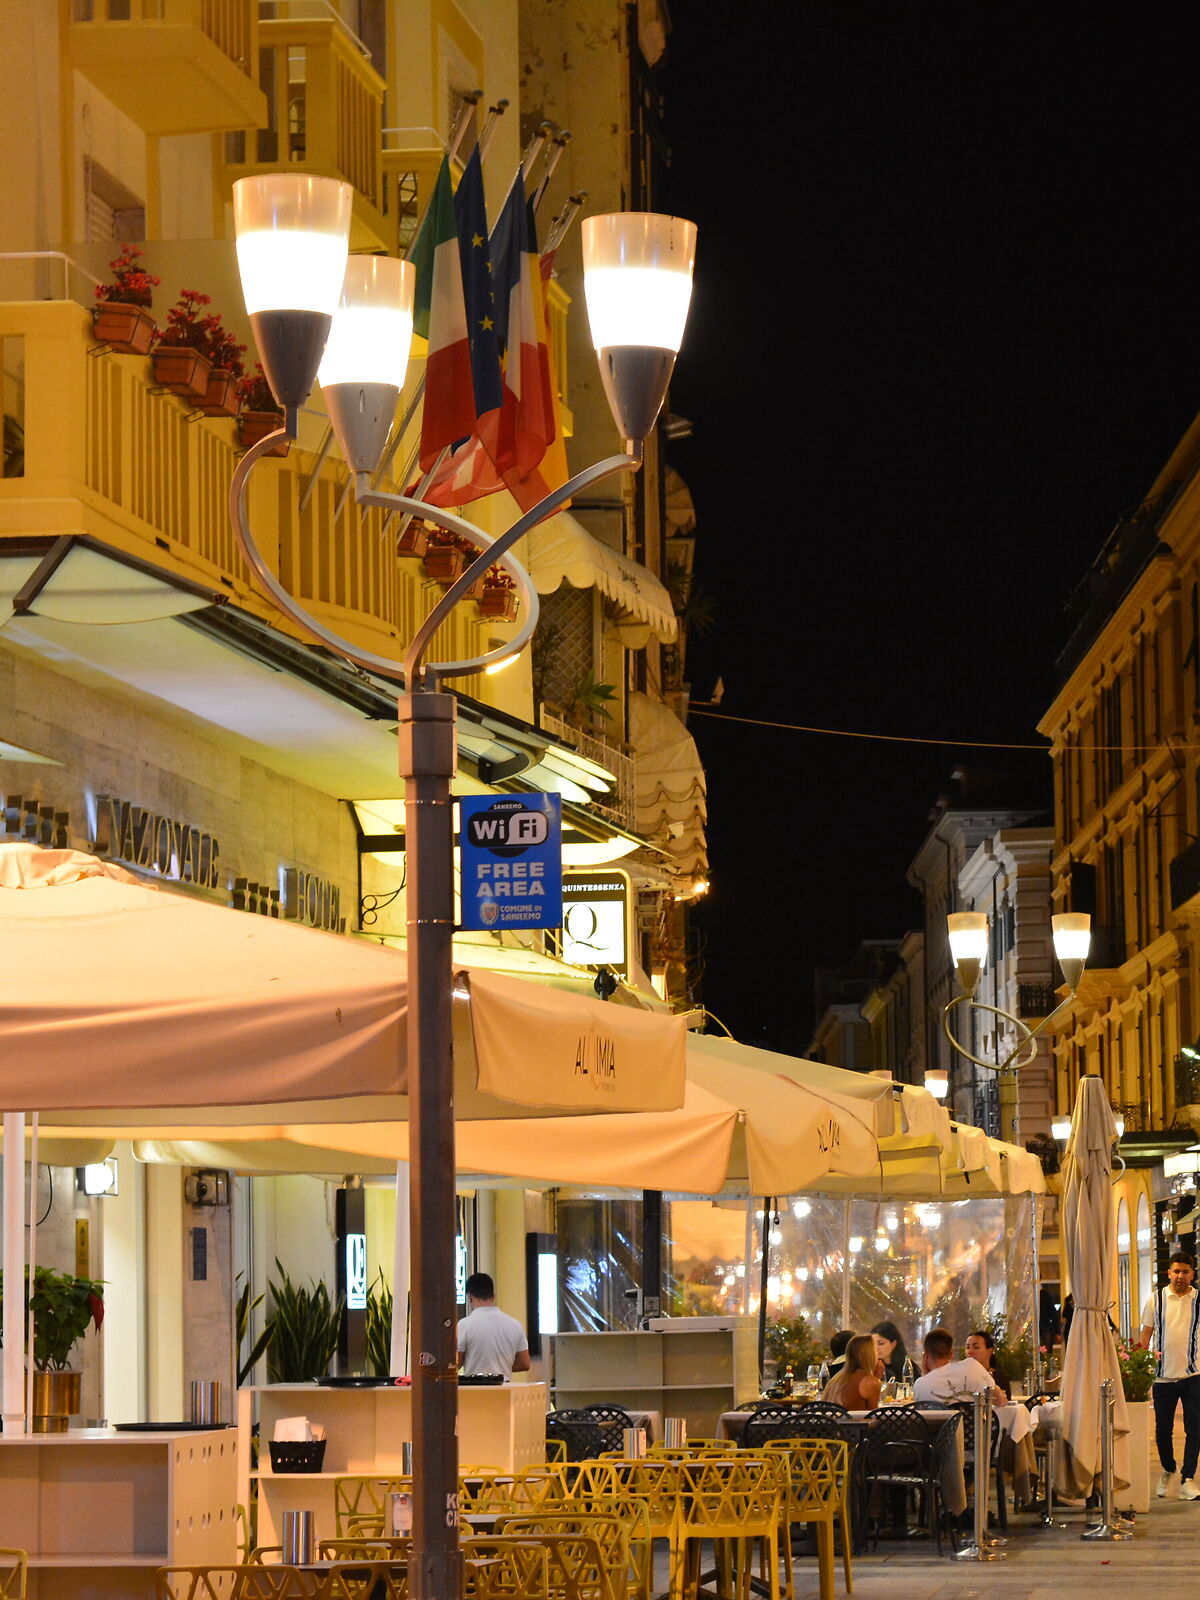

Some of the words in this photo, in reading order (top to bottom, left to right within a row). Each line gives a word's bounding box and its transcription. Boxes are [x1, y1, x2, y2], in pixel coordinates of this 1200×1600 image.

[477, 862, 545, 880] FREE
[476, 881, 546, 898] AREA
[562, 884, 625, 892] QUINTESSENZA
[500, 905, 533, 913] COMUNE
[501, 913, 541, 921] SANREMO
